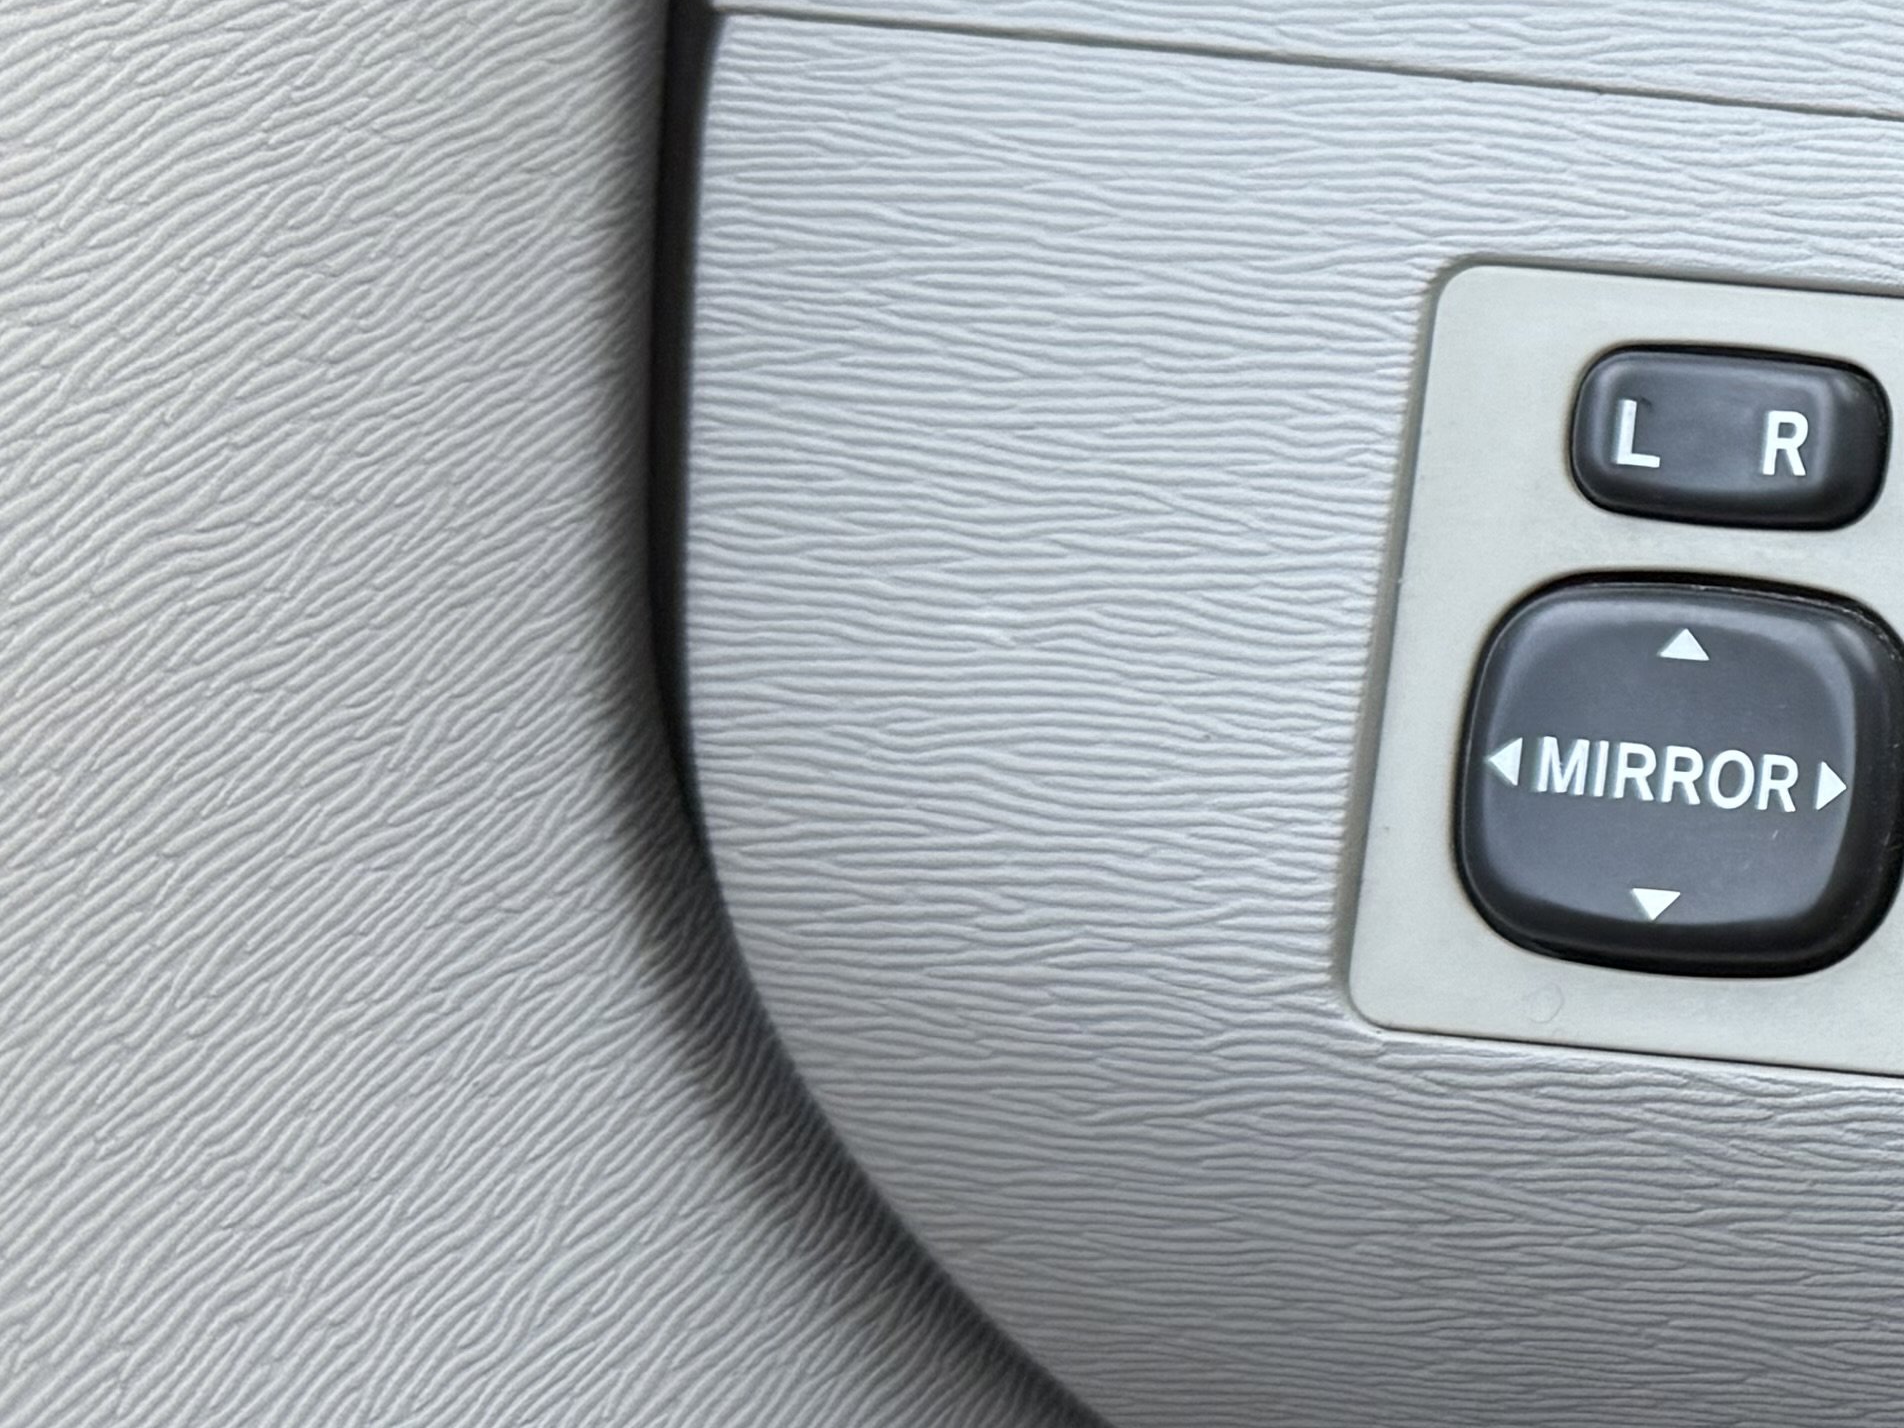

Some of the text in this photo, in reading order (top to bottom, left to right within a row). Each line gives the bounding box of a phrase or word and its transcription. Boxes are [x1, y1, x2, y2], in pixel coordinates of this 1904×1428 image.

[1615, 400, 1810, 476] L R
[1536, 736, 1800, 813] MIRROR
